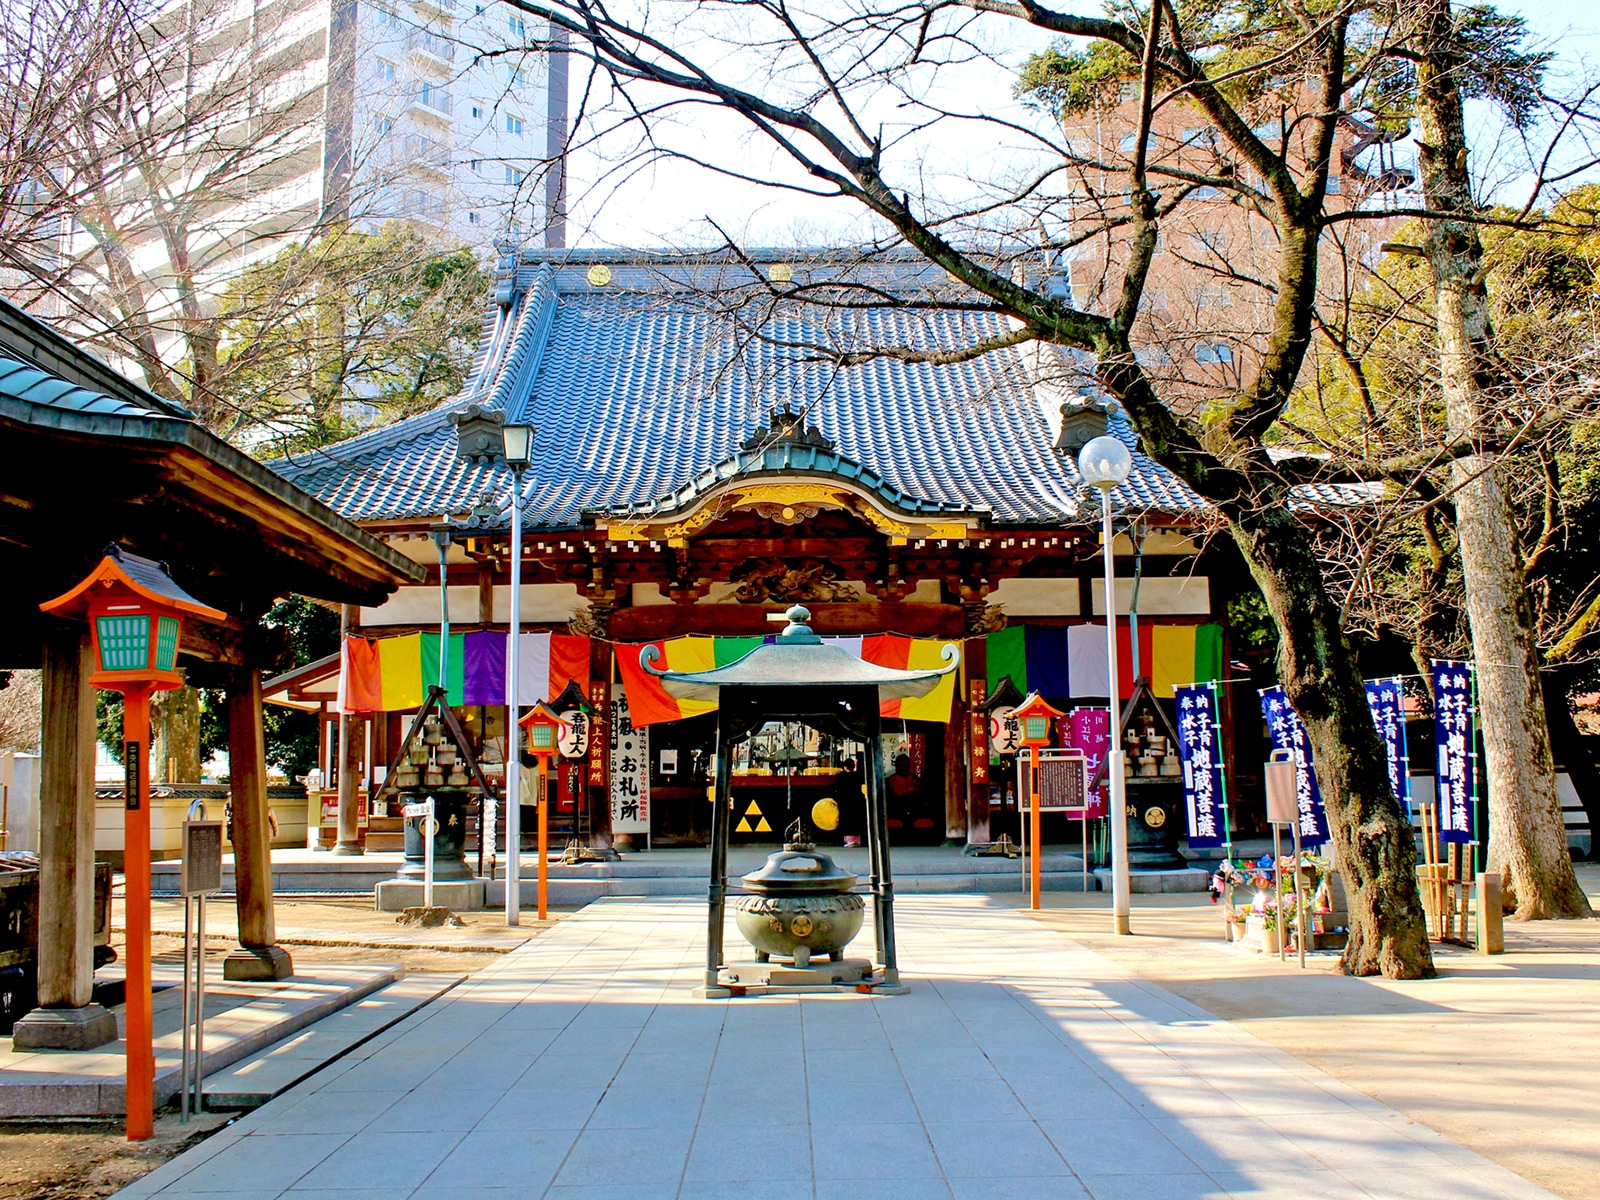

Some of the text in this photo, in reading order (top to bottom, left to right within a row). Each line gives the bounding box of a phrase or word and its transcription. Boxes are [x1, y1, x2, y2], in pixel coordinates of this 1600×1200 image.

[1438, 673, 1467, 689] 奉納
[1180, 694, 1209, 710] 奉納
[1438, 693, 1455, 731] 水子
[569, 712, 586, 754] 呑龍上人
[1181, 714, 1199, 747] 水子
[1272, 717, 1292, 748] 水子
[1382, 706, 1400, 799] 子育地蔵
[1446, 693, 1469, 833] 子育地蔵菩薩
[1190, 712, 1217, 838] 子育地蔵菩薩
[1287, 712, 1320, 836] 子育地蔵菩薩
